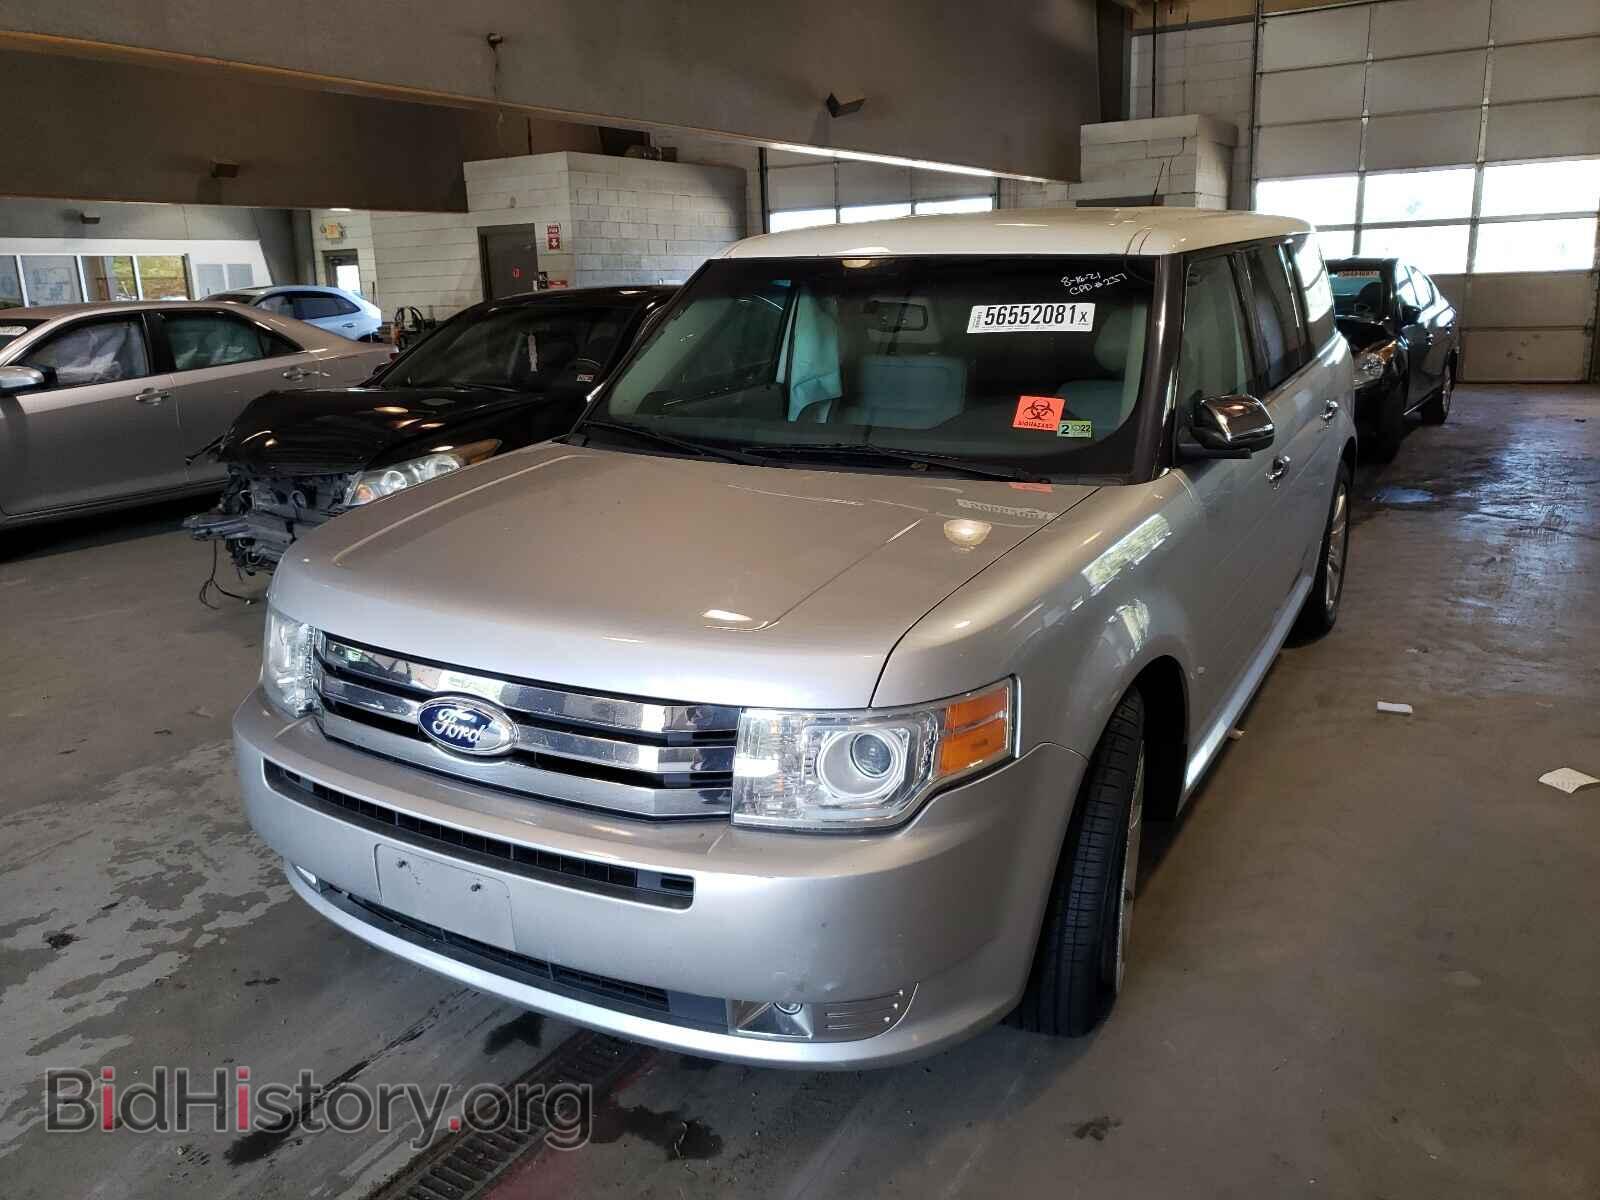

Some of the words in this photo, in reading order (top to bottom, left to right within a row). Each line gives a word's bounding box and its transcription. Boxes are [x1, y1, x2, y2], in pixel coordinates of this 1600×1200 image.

[984, 304, 1077, 326] 56552081
[1061, 424, 1070, 435] 2
[1081, 424, 1091, 433] 22
[432, 708, 486, 743] Ford
